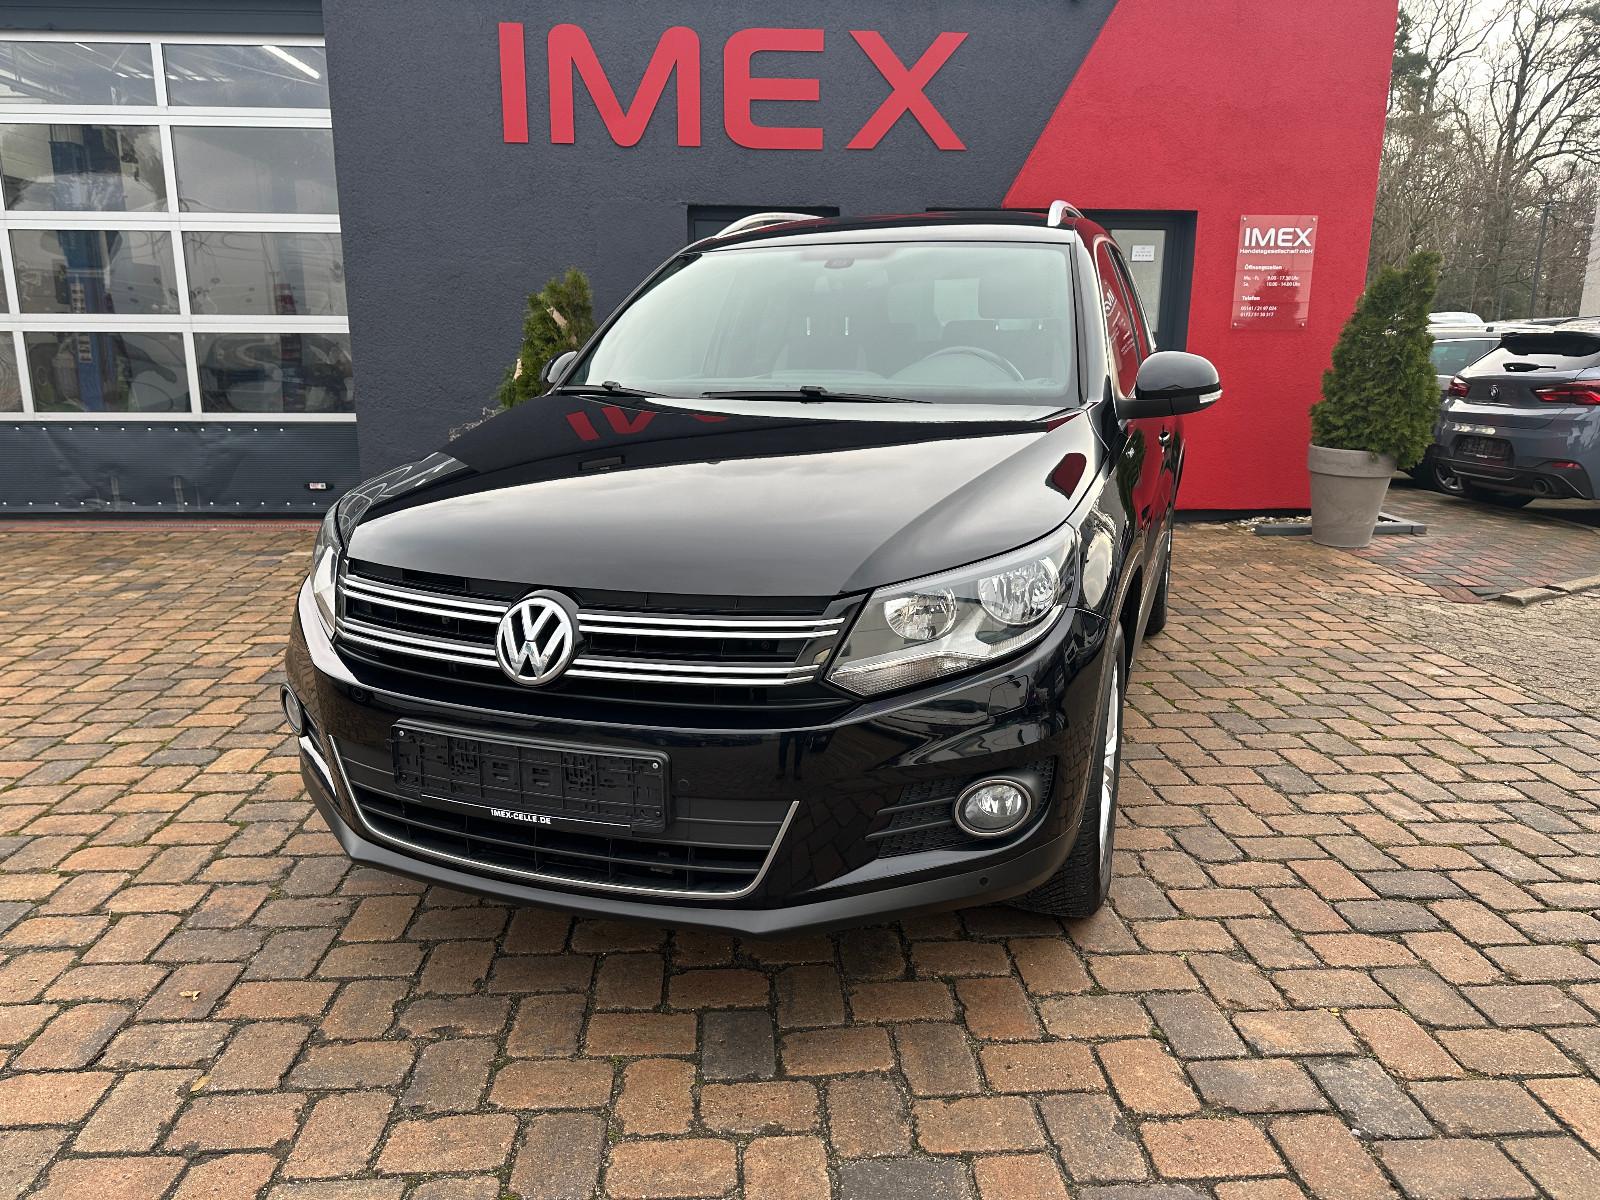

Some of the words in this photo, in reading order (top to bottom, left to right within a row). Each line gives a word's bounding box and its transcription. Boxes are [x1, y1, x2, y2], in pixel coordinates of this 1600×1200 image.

[498, 22, 968, 151] IMEX
[1244, 227, 1313, 247] IMEX
[490, 808, 552, 825] IMEX-CELLE.DE
